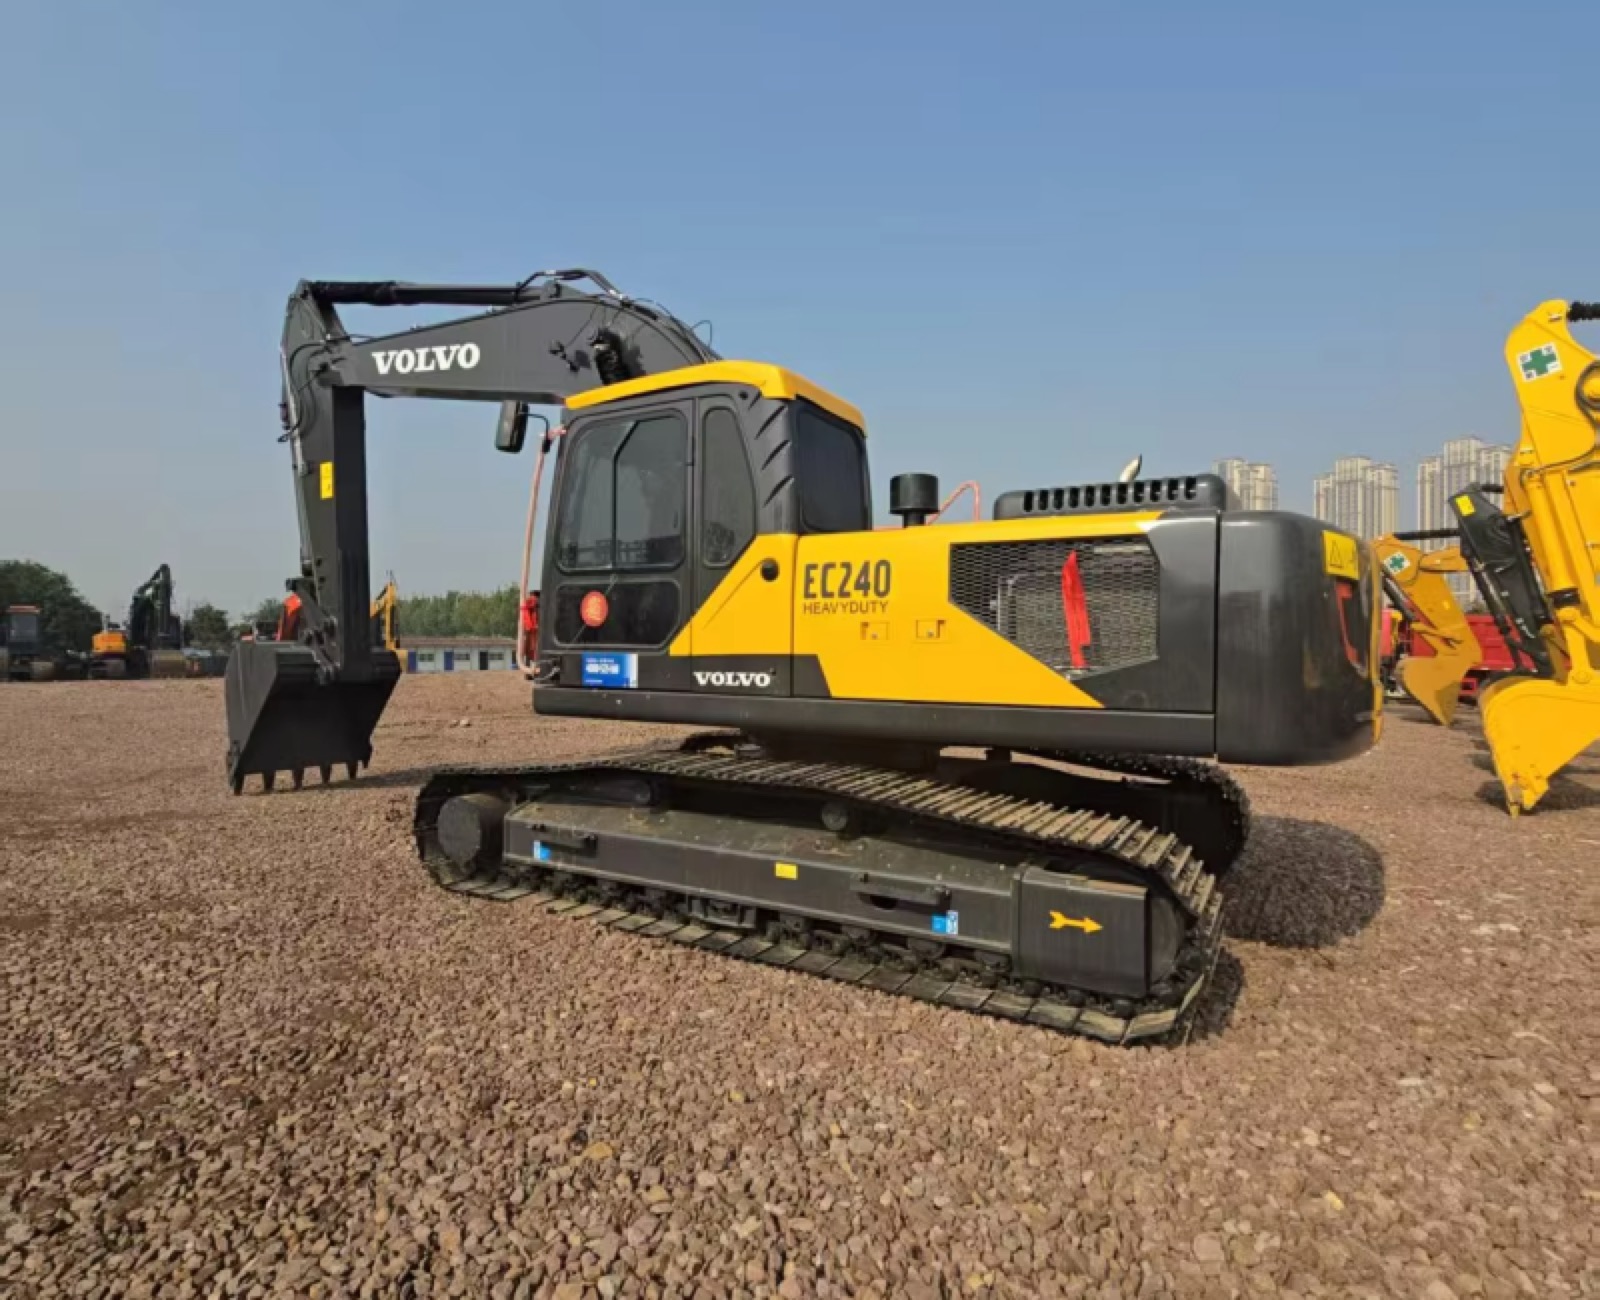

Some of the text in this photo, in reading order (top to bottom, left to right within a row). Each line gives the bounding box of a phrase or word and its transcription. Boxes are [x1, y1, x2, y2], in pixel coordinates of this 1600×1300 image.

[371, 342, 480, 374] VOLVO
[803, 559, 891, 599] EC240
[694, 671, 771, 687] VOLVO
